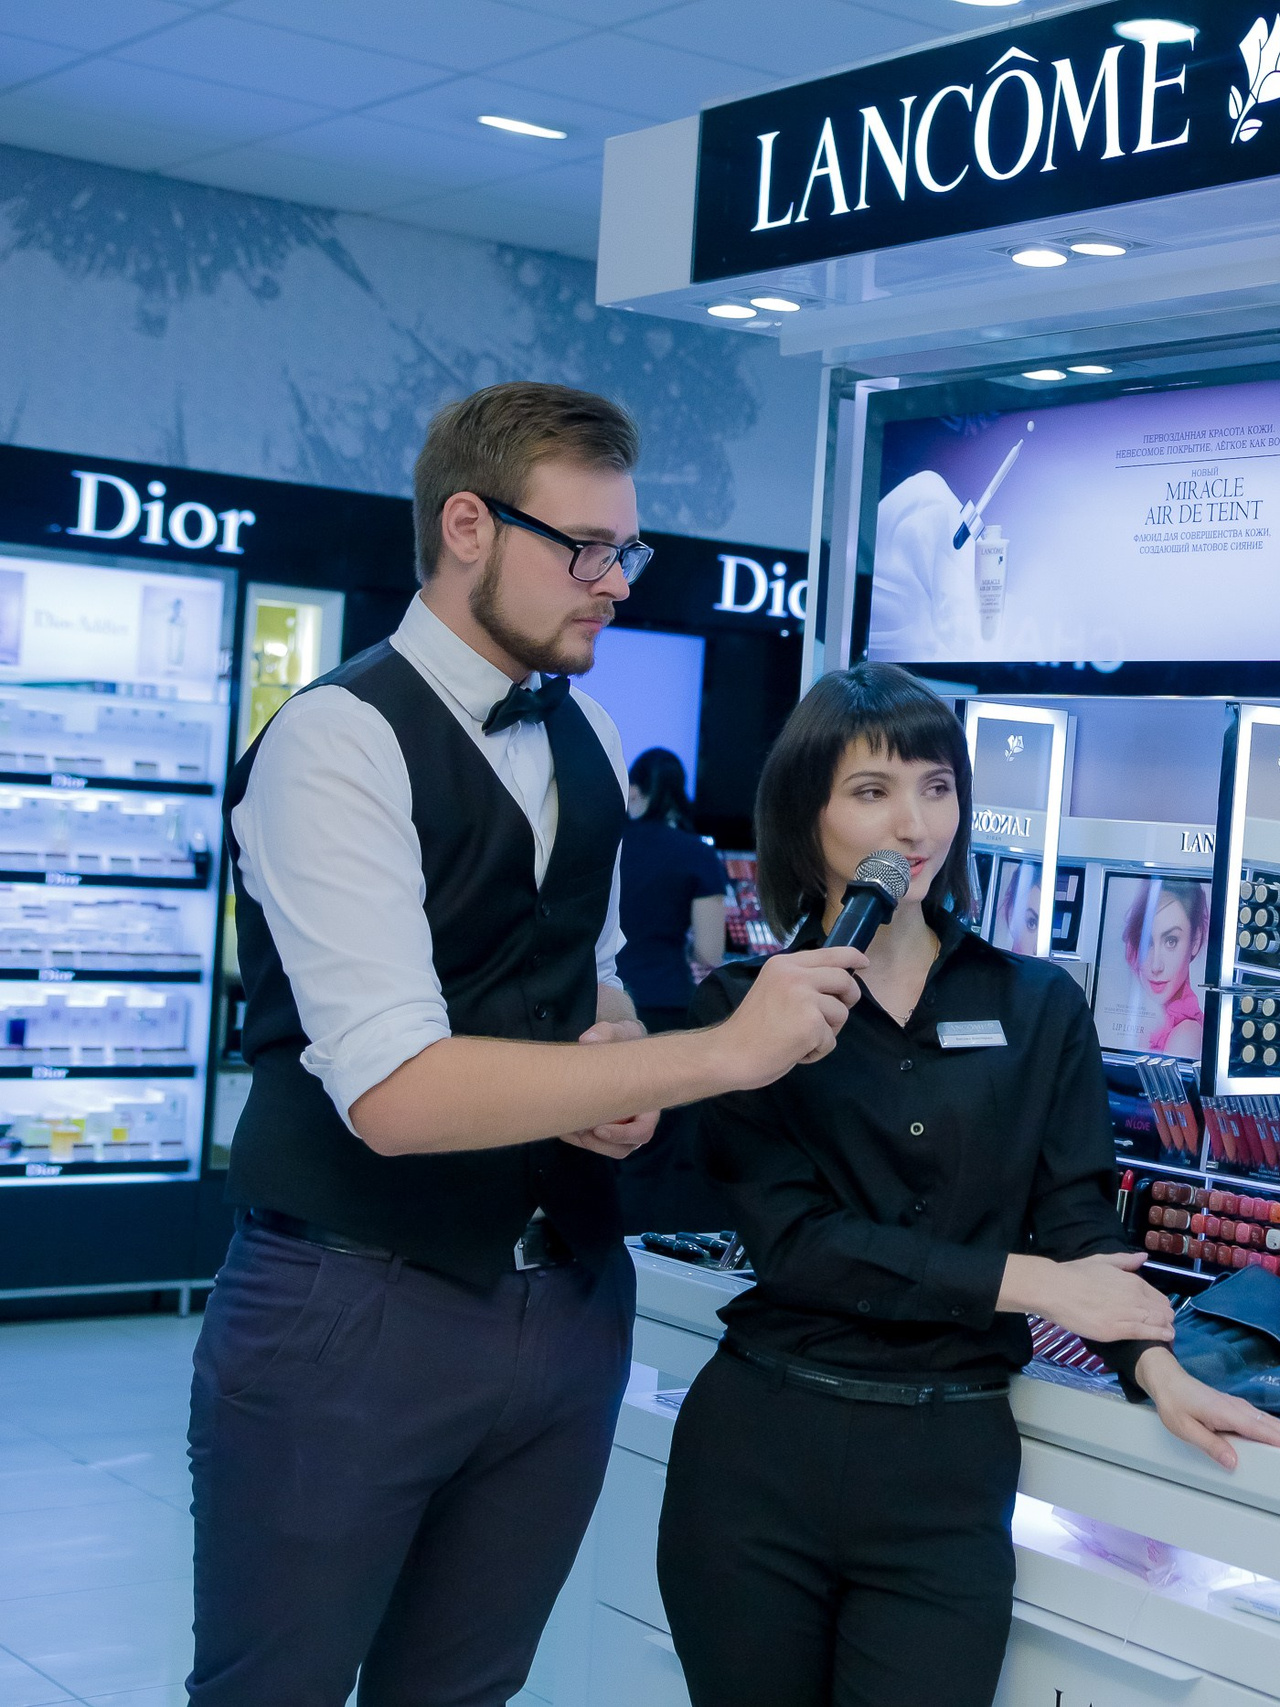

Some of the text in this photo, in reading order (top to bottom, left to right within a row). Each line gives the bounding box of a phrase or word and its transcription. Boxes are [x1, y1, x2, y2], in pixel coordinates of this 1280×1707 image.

[750, 27, 1196, 233] LANCÔME
[1143, 424, 1275, 444] ПЕРВОЗДАННАЯ КРАСОТА КОЖИ.
[1116, 446, 1165, 459] НЕВЕСОМОЕ
[1215, 439, 1247, 451] ЛЁГКОЕ
[1249, 437, 1266, 448] КАК
[1191, 466, 1219, 477] НОВЫЙ
[1165, 477, 1245, 501] MIRACLE
[65, 470, 256, 554] Dior
[1145, 500, 1263, 525] AIR DE TEINT
[1133, 533, 1162, 542] ФЛЮИД
[1163, 532, 1179, 542] ДЛЯ
[1180, 529, 1243, 541] СОВЕРШЕНСТВА
[1139, 541, 1263, 555] СОЗДАЮЩИЙ МАТОВОЕ СИЯНИЕ
